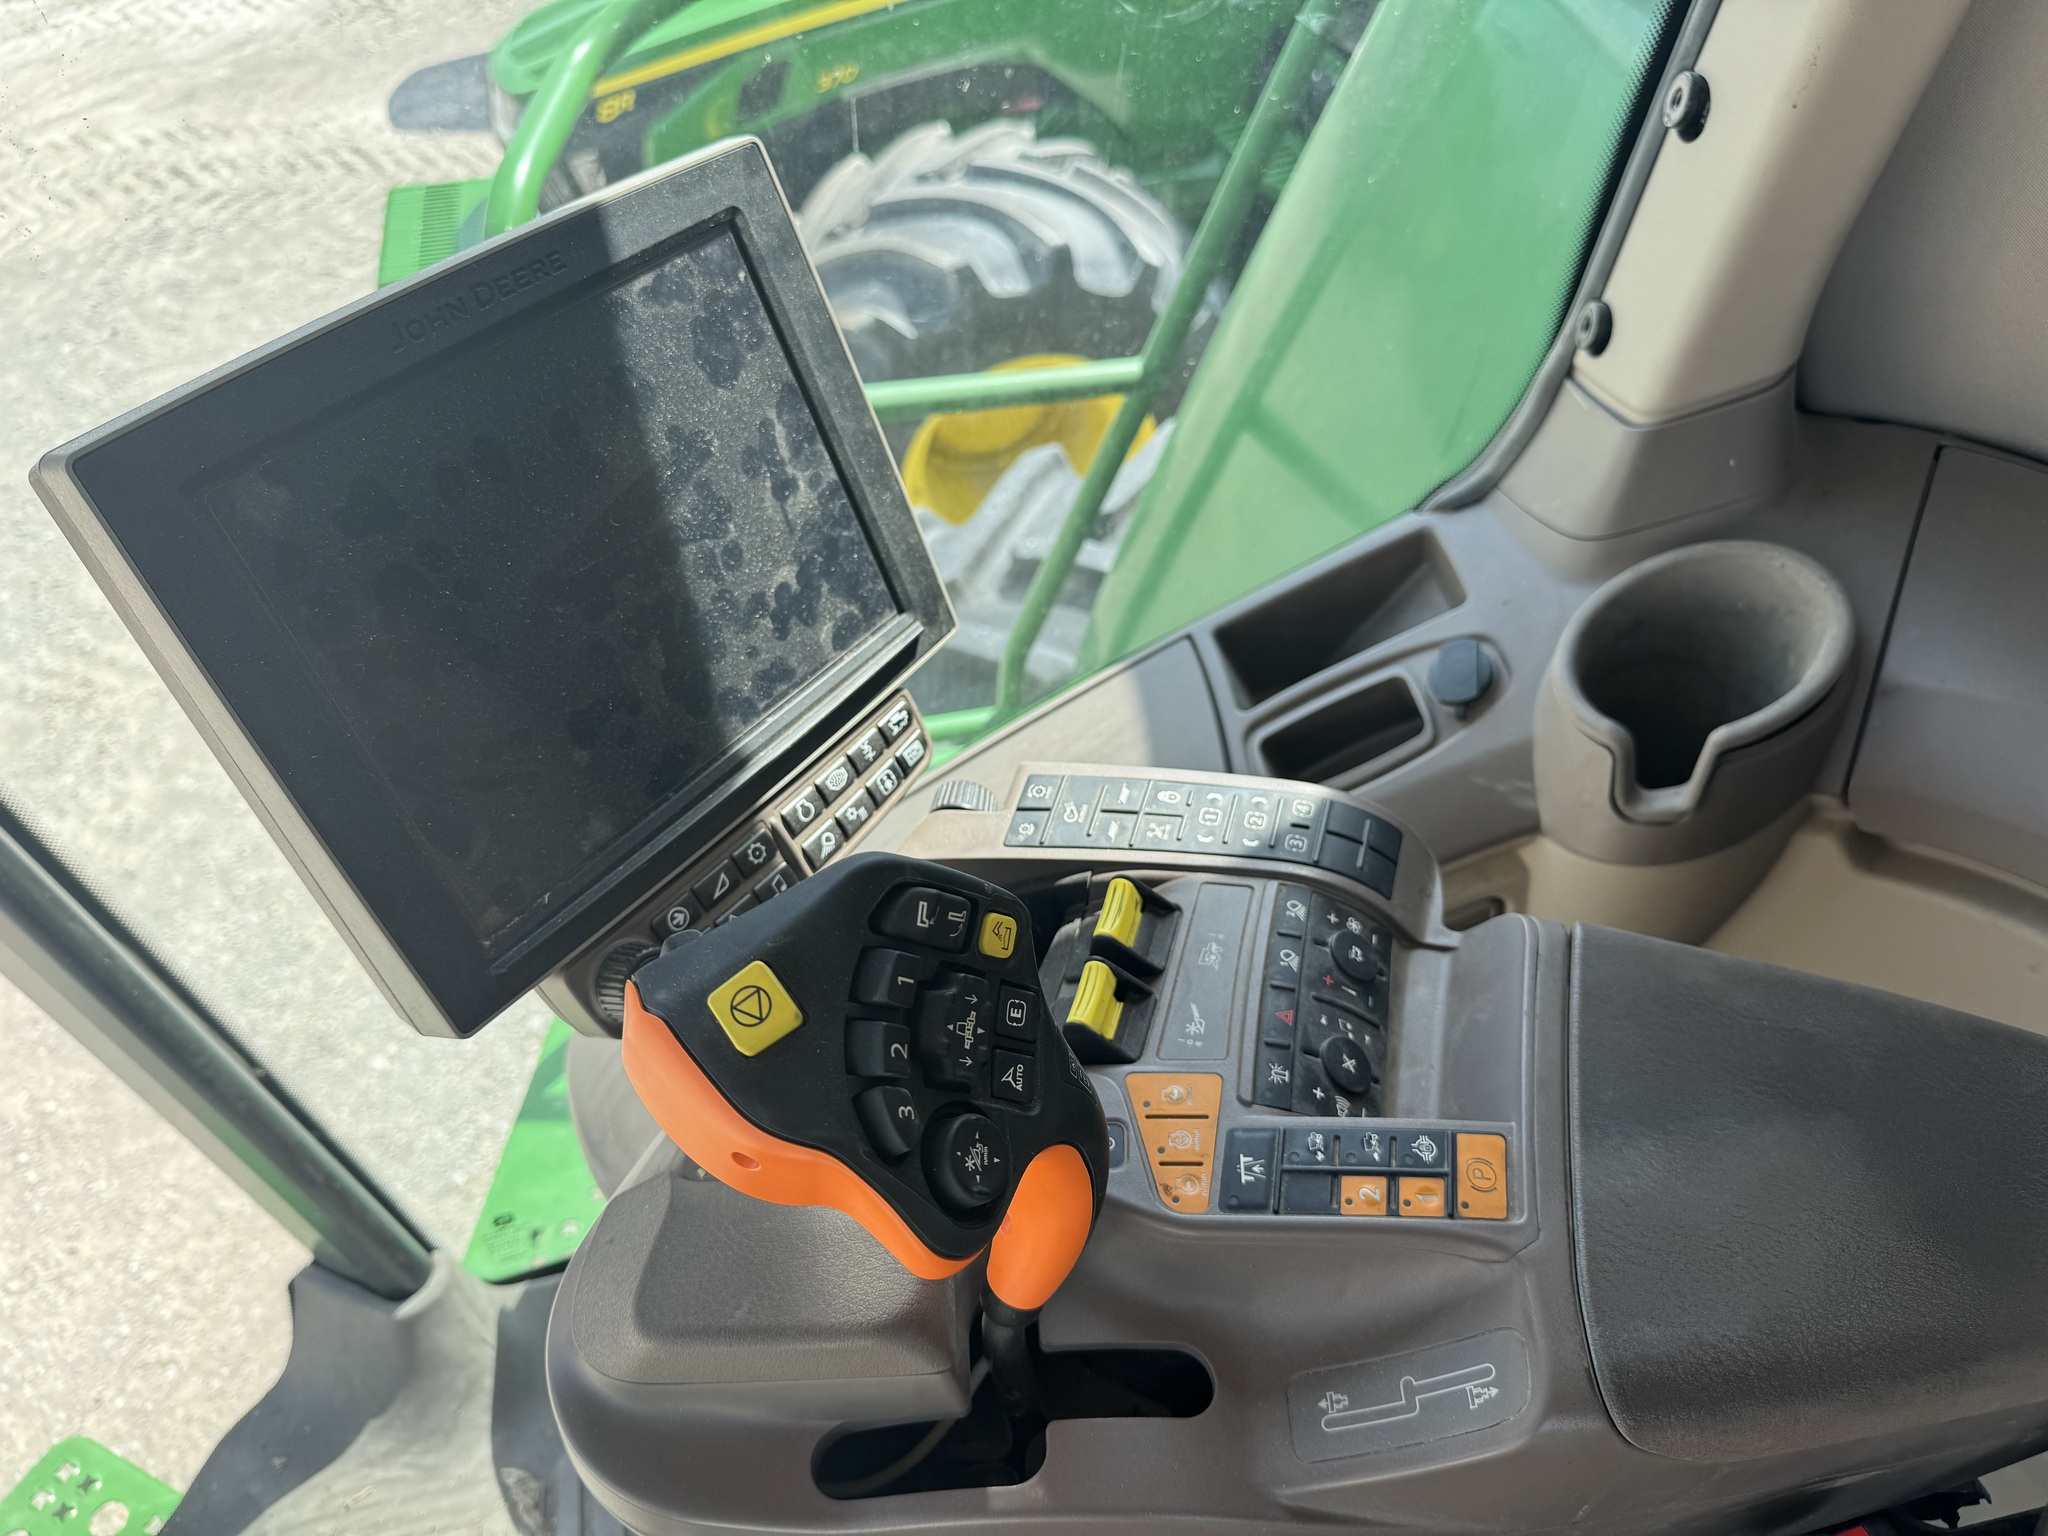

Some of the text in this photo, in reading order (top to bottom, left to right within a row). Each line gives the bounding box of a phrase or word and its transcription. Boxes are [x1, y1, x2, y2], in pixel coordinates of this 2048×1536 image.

[391, 250, 568, 354] JOHN DEERE
[1249, 815, 1263, 826] 2
[1289, 838, 1303, 848] 3
[897, 976, 915, 985] 1
[1010, 1008, 1022, 1018] E
[891, 1043, 908, 1060] 2
[1015, 1064, 1024, 1091] AUTO
[898, 1106, 915, 1120] 3
[1473, 1168, 1491, 1181] P
[1358, 1187, 1381, 1202] 2
[1416, 1193, 1437, 1203] 1
